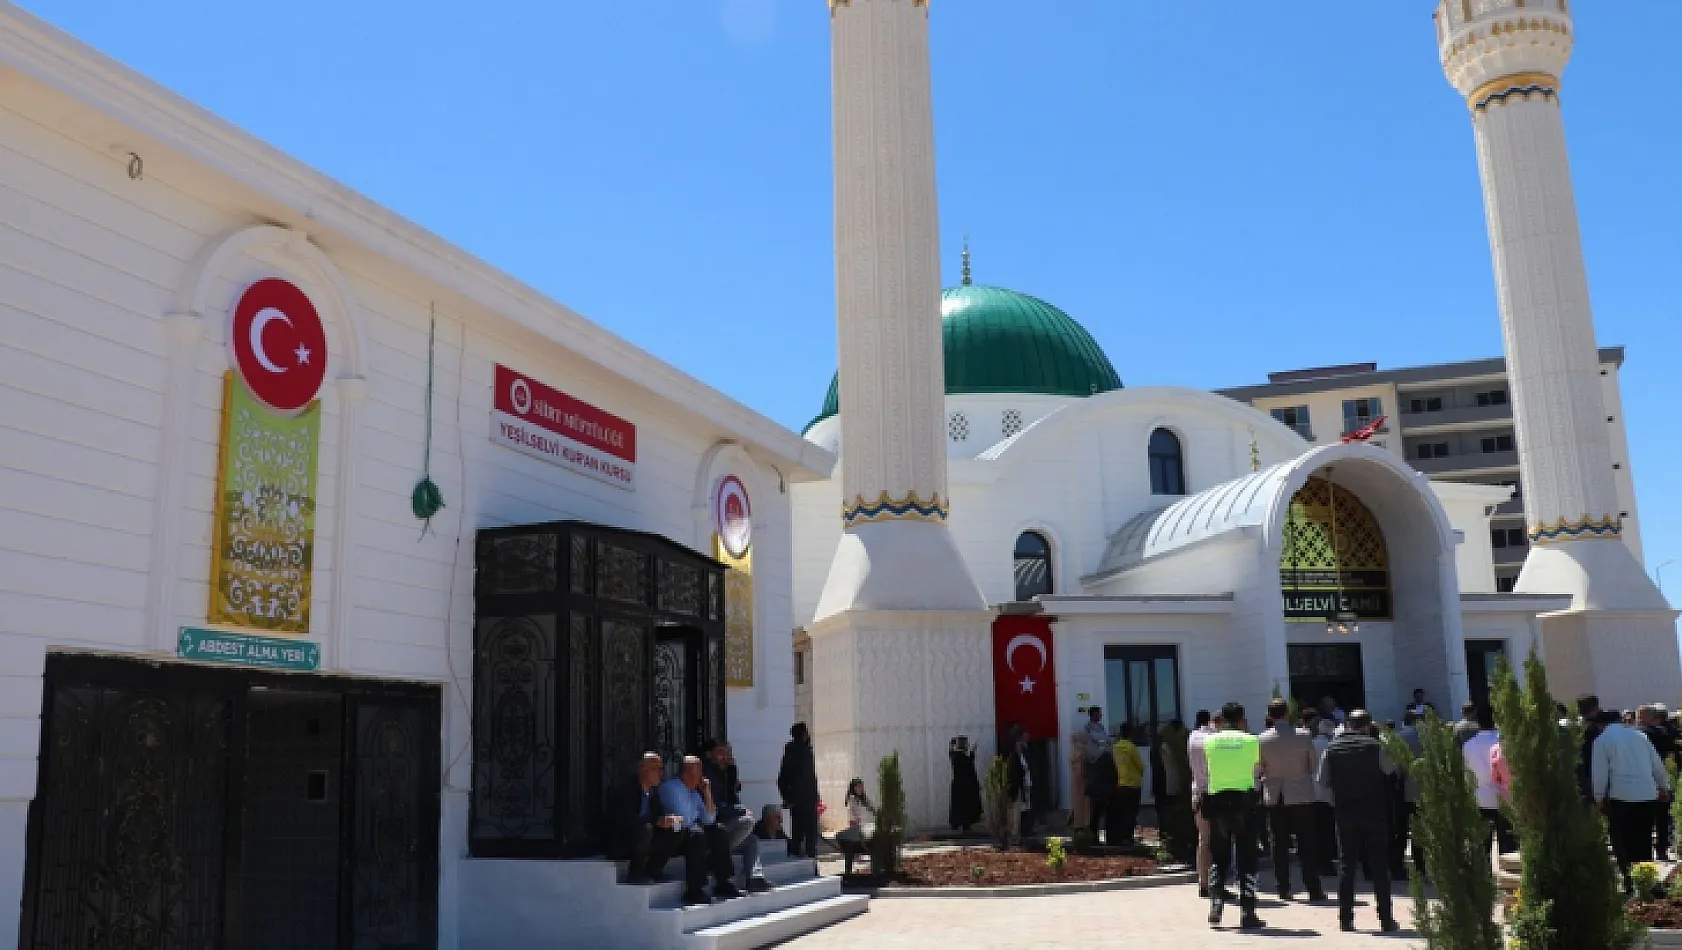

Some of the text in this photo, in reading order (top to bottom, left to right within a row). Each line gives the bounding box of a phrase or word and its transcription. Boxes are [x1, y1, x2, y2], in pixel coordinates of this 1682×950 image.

[600, 461, 631, 483] KURSU
[198, 639, 305, 663] ABDEST ALMA YERİ
